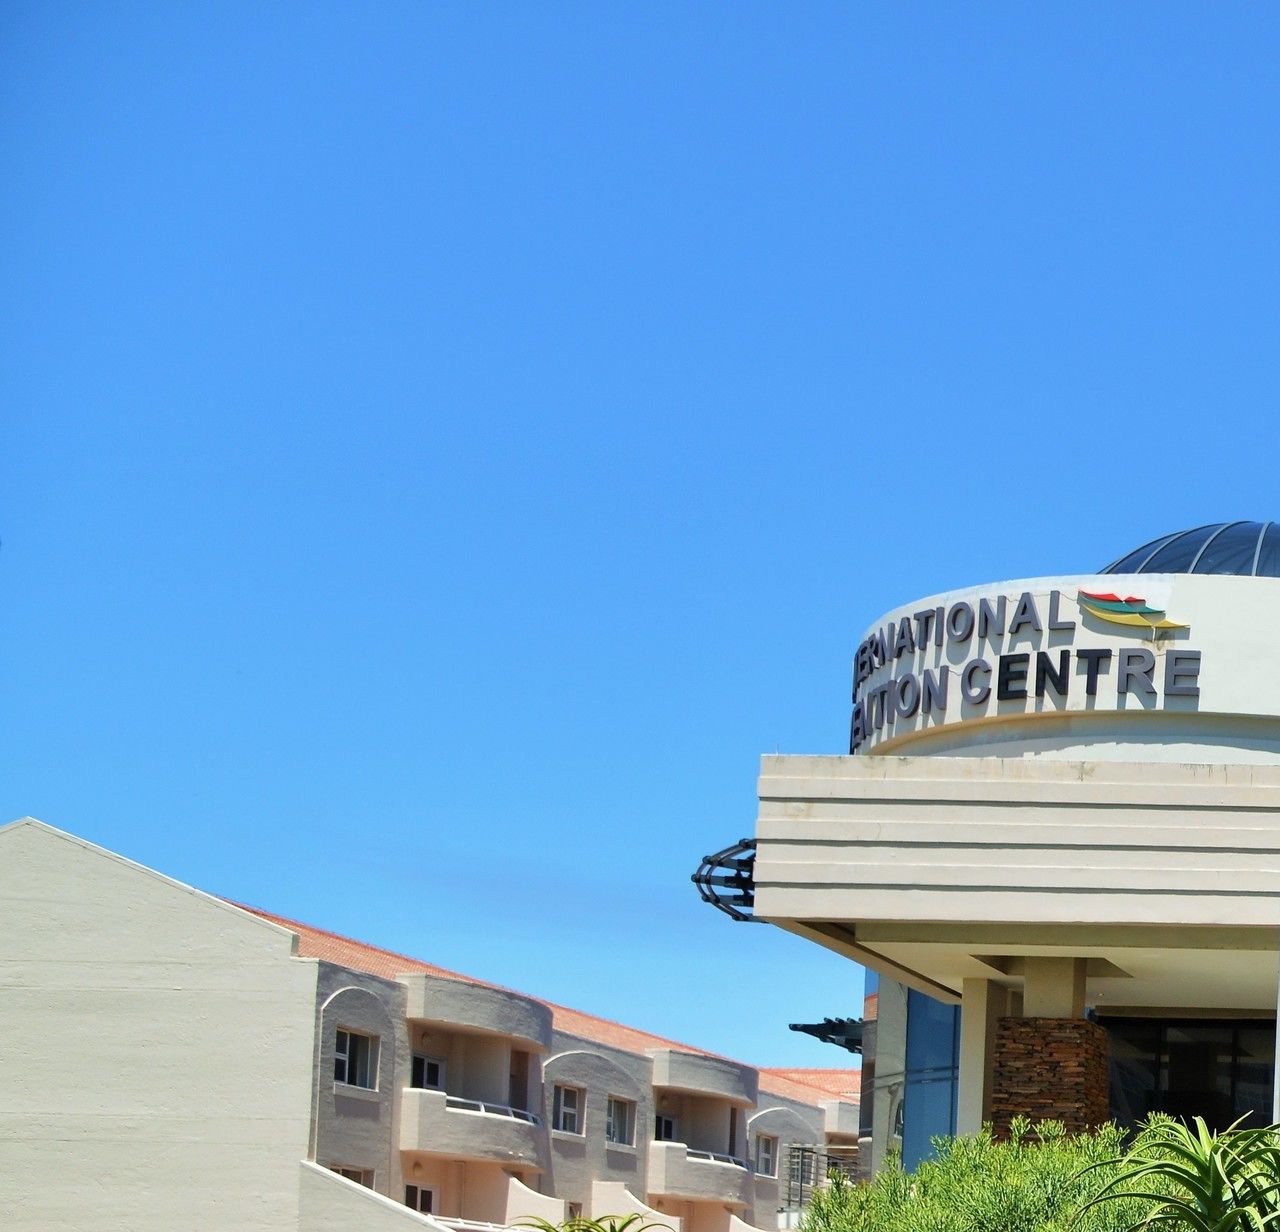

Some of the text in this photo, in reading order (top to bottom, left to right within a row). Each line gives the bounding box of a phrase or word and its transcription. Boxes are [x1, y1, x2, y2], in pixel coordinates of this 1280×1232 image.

[849, 647, 1201, 755] ENTION CENTRE
[852, 589, 1076, 704] ERNATIONAL
